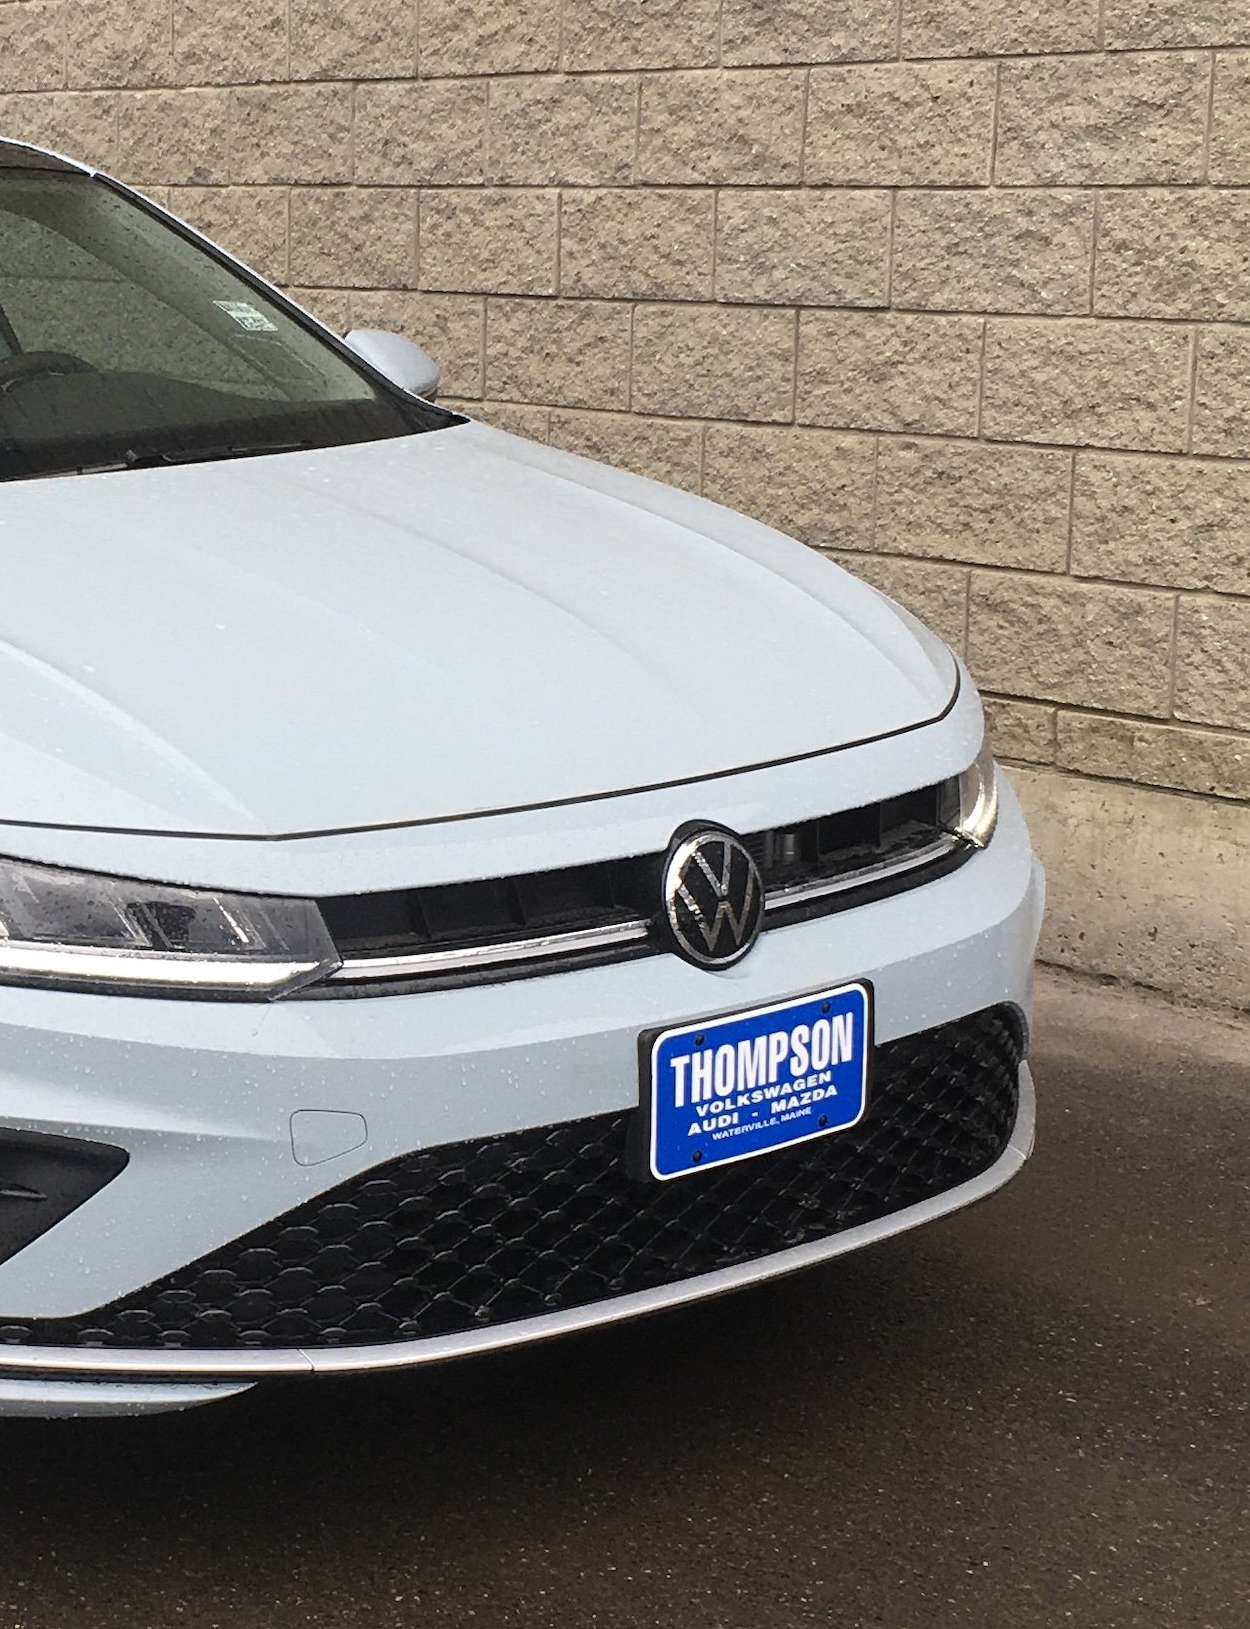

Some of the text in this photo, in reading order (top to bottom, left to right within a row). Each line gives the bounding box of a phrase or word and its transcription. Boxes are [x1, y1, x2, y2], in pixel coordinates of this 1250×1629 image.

[669, 837, 760, 957] VW
[670, 1012, 853, 1108] THOMPSON
[687, 1112, 739, 1136] AUDI
[771, 1085, 838, 1115] MAZDA
[696, 1070, 831, 1117] VOLKSWAGEN
[712, 1107, 812, 1140] WATERVILLE, MAINE
